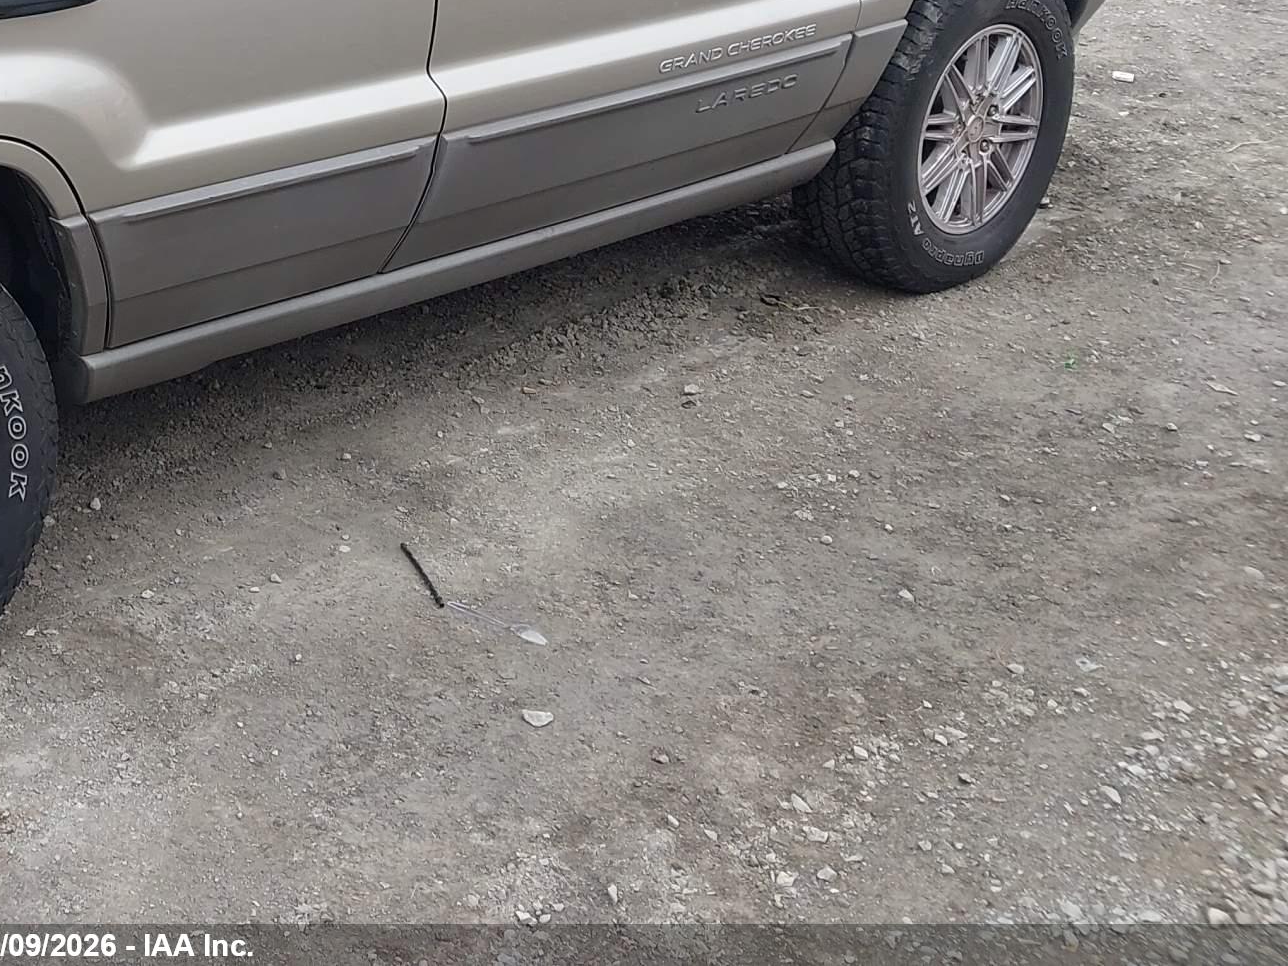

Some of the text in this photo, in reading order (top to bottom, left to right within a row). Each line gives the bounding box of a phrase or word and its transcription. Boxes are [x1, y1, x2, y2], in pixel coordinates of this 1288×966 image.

[659, 24, 817, 74] GRAND CHEROKEE
[696, 73, 798, 113] LAREDO
[907, 200, 924, 235] AT2
